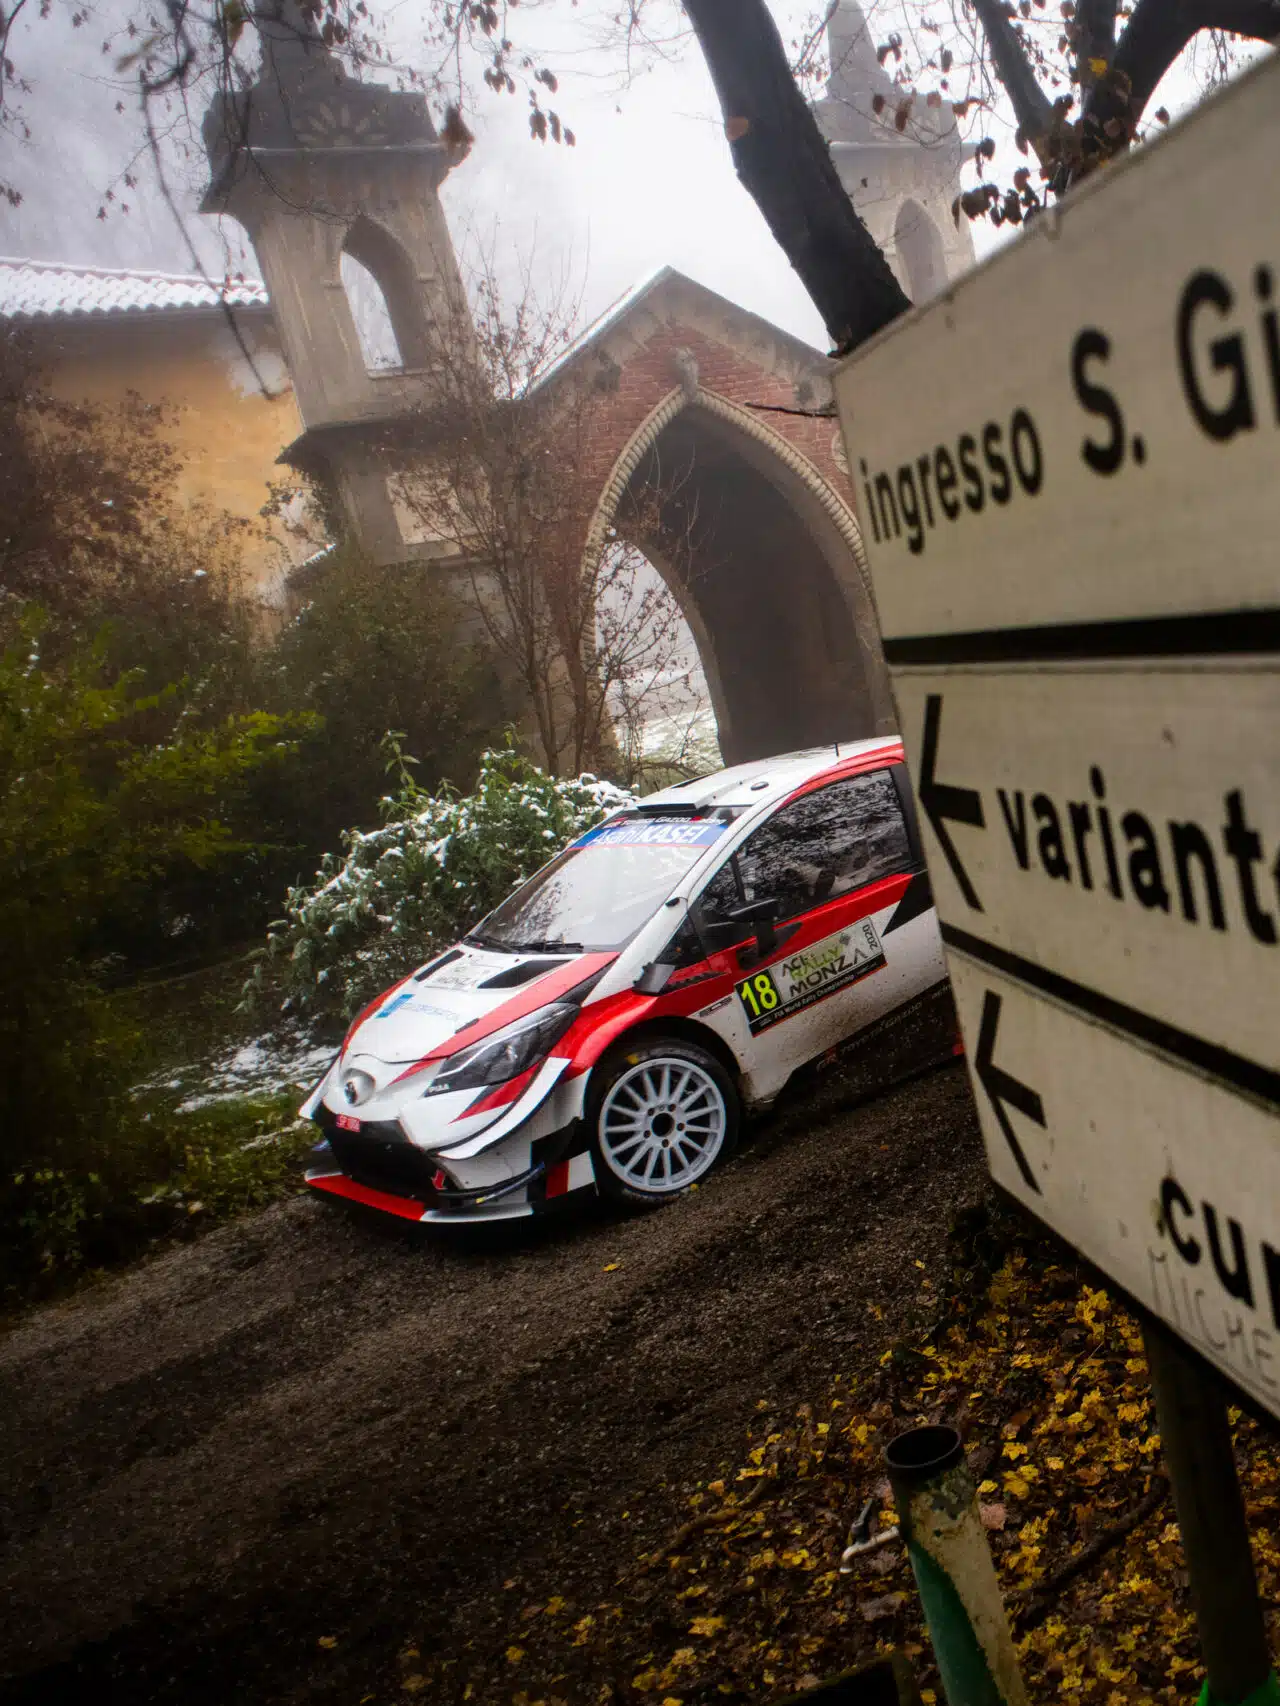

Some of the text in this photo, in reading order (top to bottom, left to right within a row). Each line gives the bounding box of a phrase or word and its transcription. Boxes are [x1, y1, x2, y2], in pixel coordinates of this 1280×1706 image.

[860, 404, 1044, 555] ingresso
[1070, 325, 1146, 477] S.
[862, 923, 879, 951] 2020
[740, 974, 778, 1017] 18
[788, 947, 869, 998] MONZA
